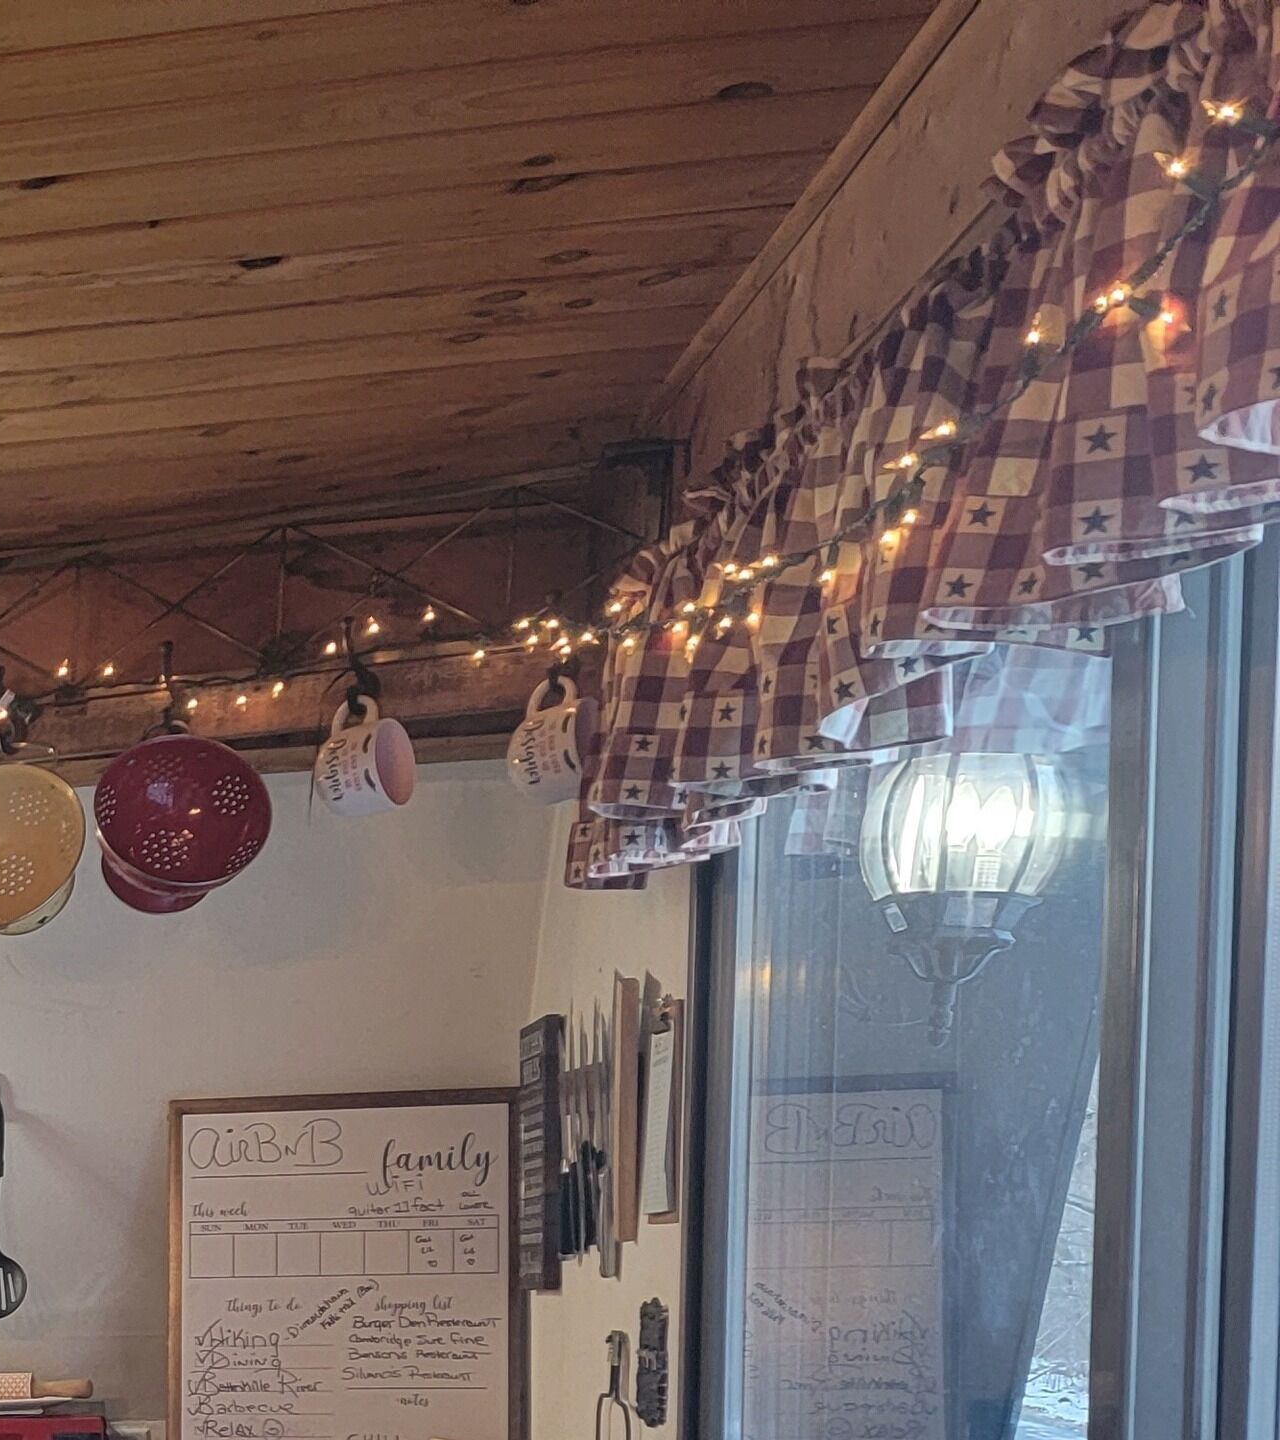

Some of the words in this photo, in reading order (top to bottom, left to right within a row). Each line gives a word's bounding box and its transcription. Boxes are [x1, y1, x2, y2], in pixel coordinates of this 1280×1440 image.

[383, 1132, 499, 1187] family
[193, 1202, 214, 1217] this
[220, 1202, 248, 1217] week
[288, 1222, 308, 1230] TUE
[332, 1221, 357, 1229] WED
[423, 1219, 439, 1227] FRI
[467, 1218, 487, 1226] SAT
[243, 1223, 269, 1231] MON
[374, 1296, 426, 1316] shopping
[433, 1294, 453, 1311] list
